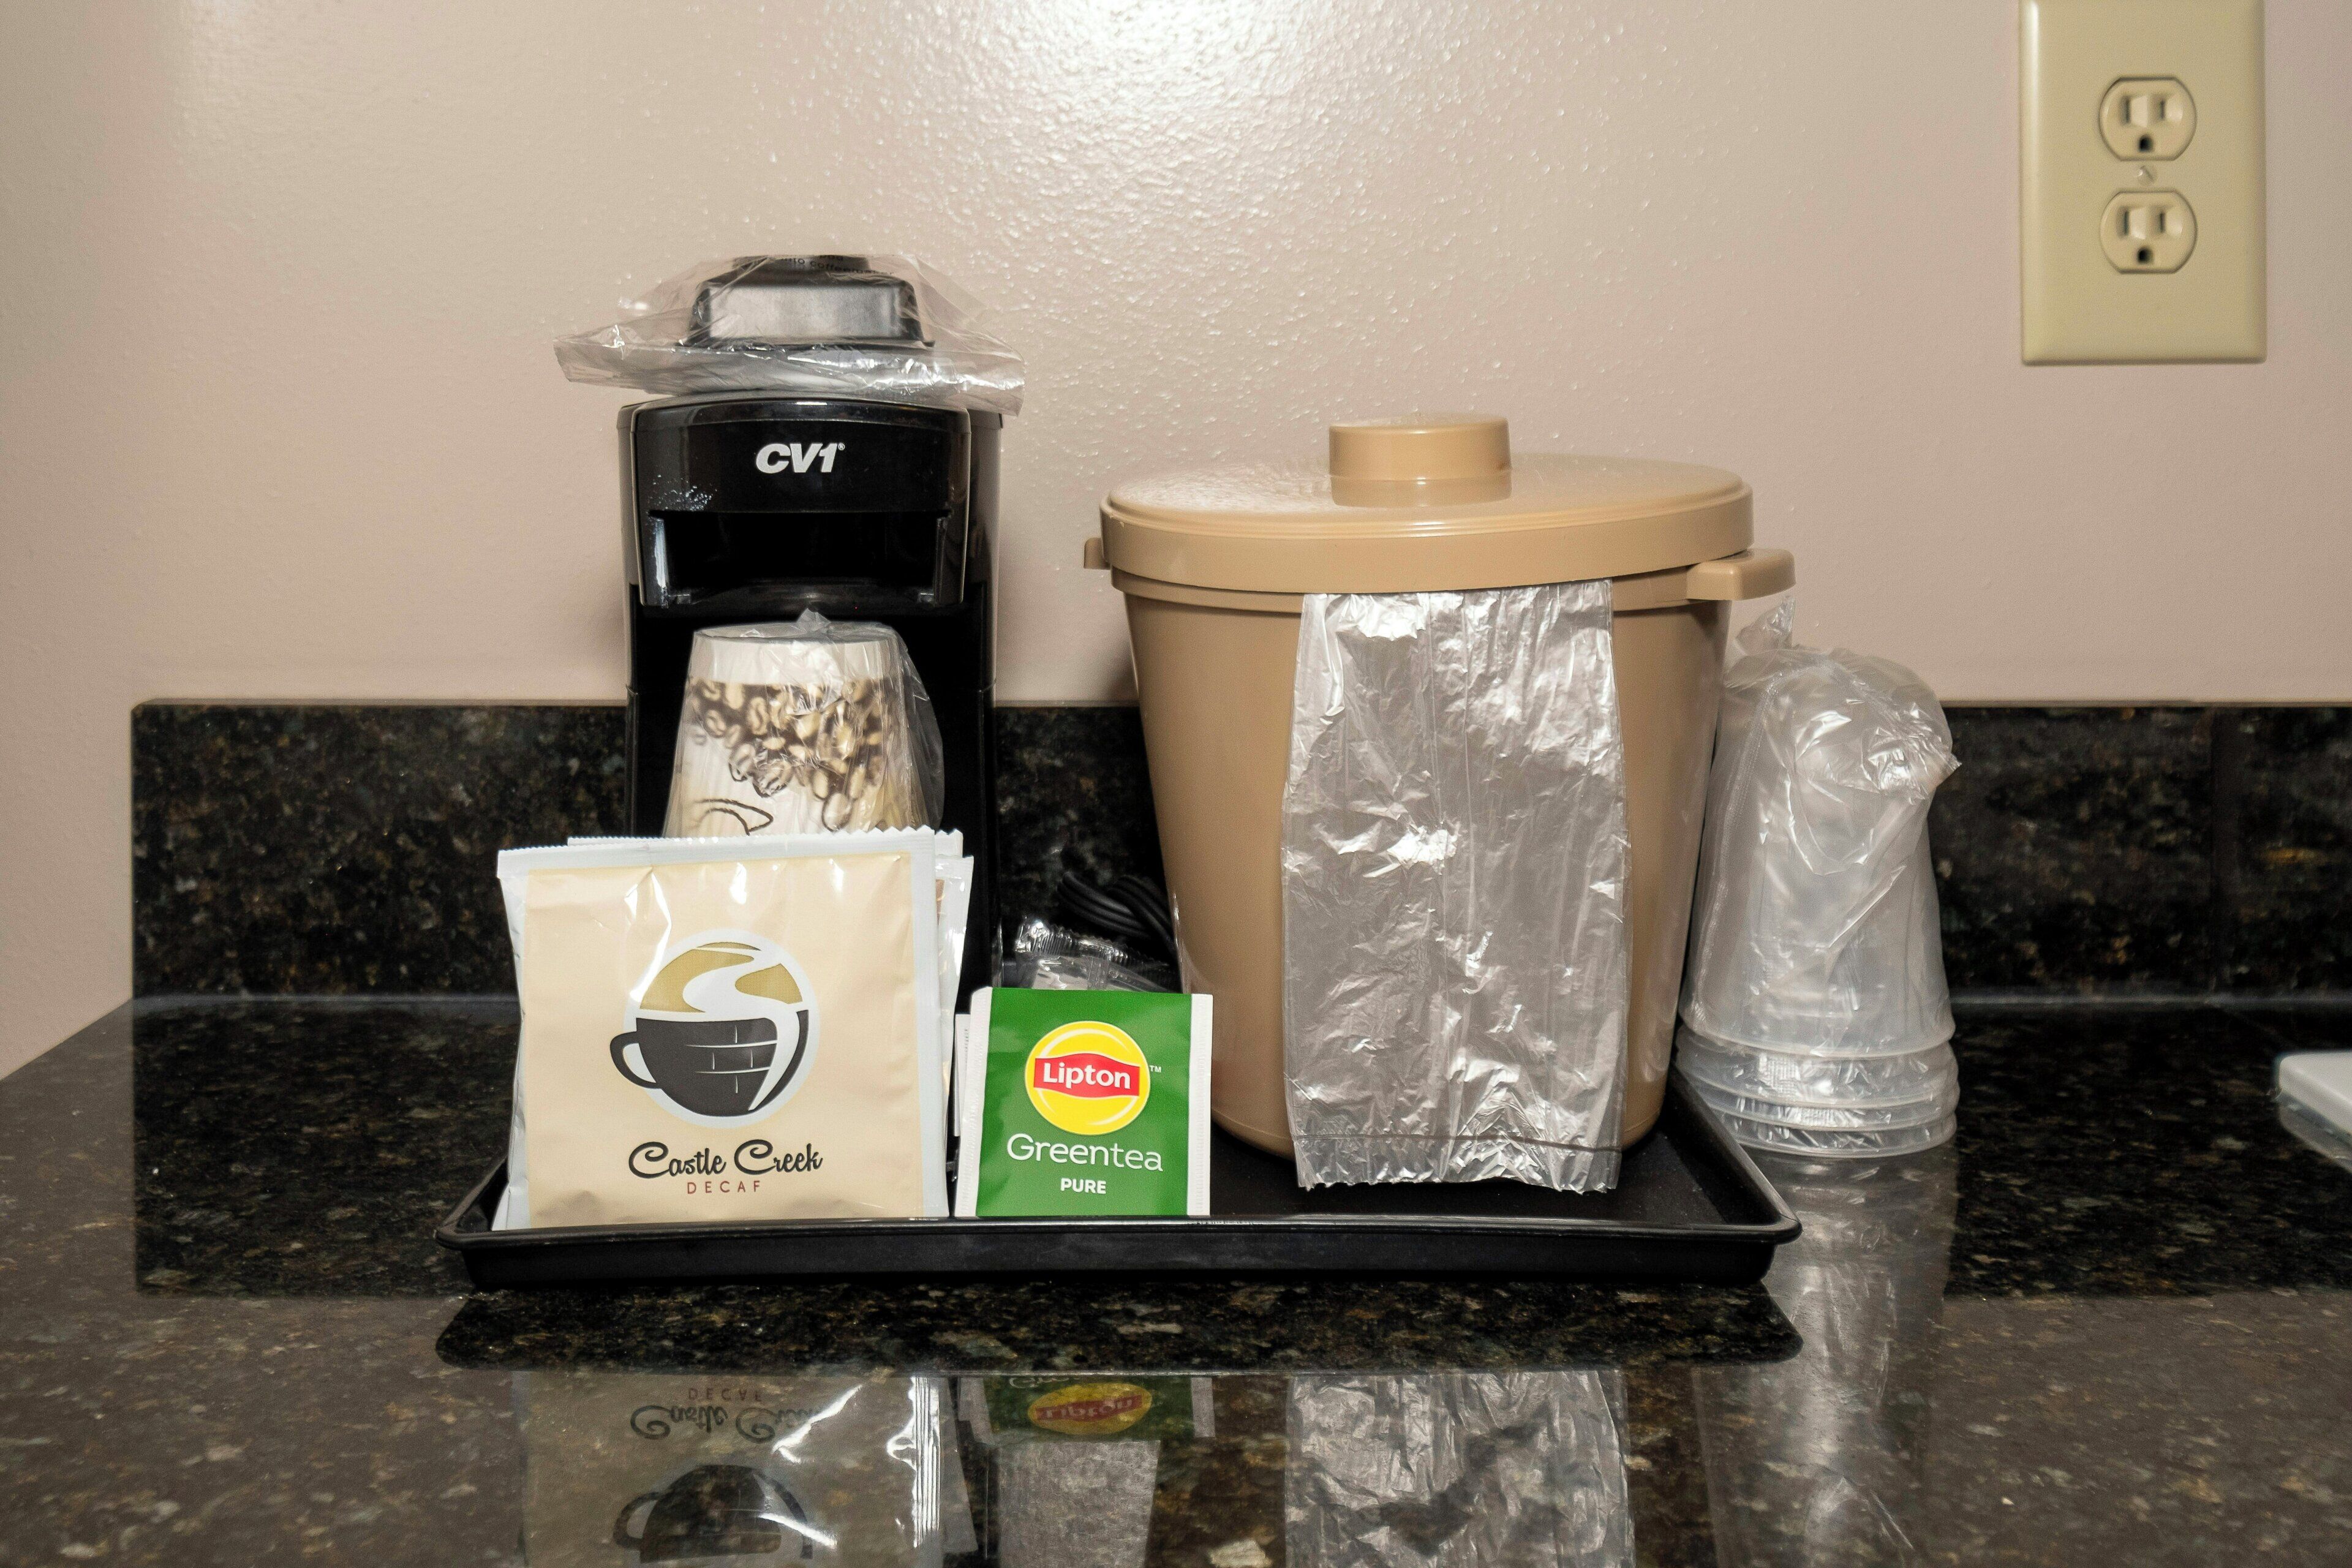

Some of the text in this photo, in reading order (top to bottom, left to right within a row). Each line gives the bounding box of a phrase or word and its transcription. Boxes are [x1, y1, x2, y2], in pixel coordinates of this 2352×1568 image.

[1042, 1061, 1131, 1090] Lipton
[628, 1139, 823, 1179] Castle Creek
[1006, 1133, 1164, 1172] Greentea
[687, 1180, 761, 1194] DECAF
[1060, 1177, 1107, 1194] PURE
